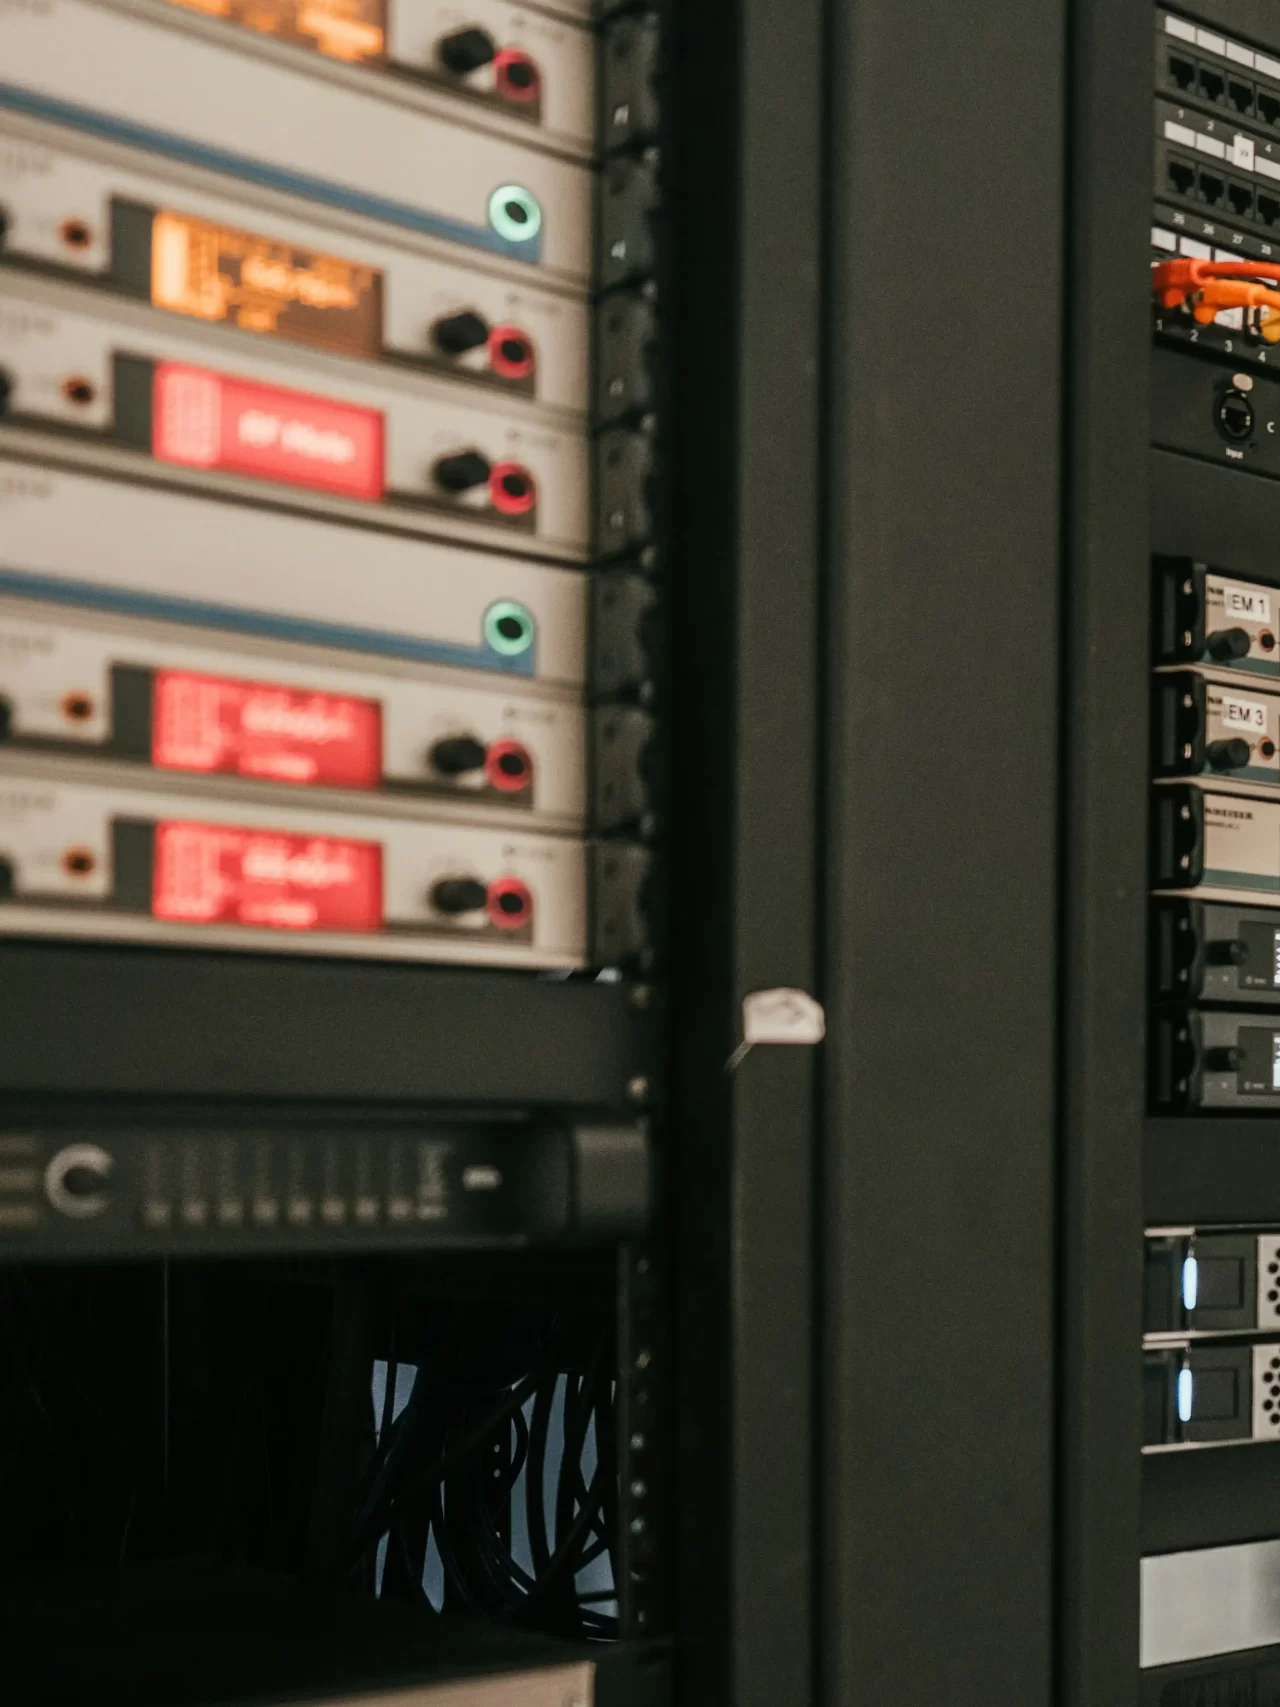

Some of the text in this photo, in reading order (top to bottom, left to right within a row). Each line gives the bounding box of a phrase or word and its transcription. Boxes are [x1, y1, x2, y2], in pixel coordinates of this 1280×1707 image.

[1190, 328, 1199, 343] 2
[1225, 340, 1233, 353] 3
[1258, 351, 1266, 363] 4
[1266, 422, 1276, 433] C
[1255, 710, 1264, 726] 3
